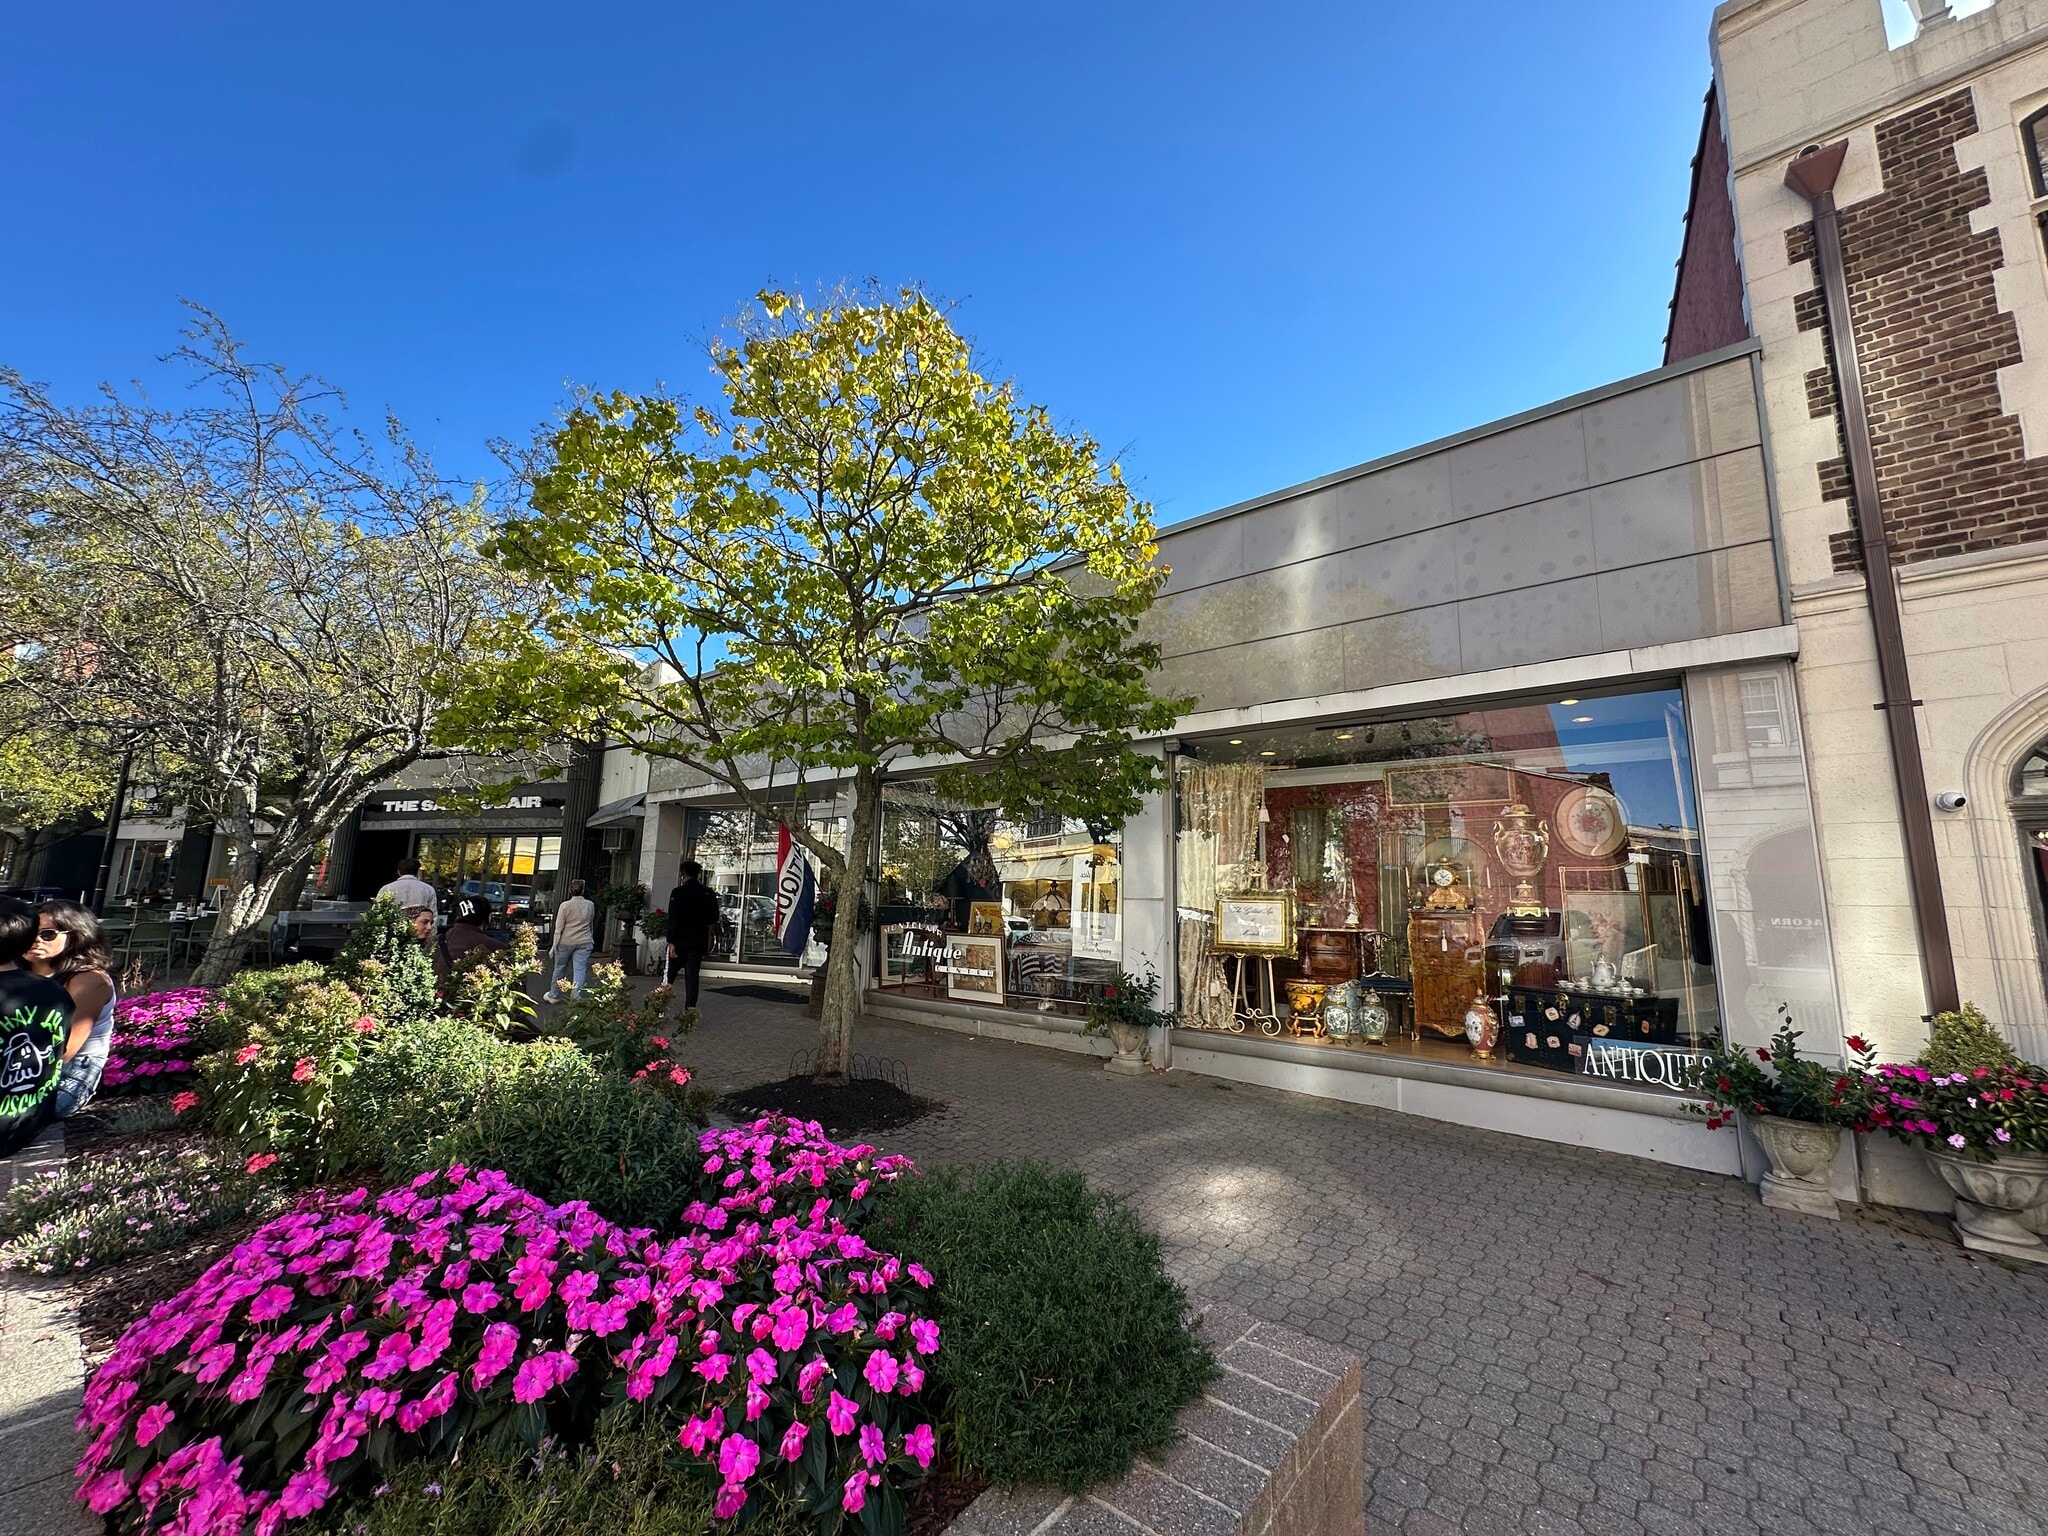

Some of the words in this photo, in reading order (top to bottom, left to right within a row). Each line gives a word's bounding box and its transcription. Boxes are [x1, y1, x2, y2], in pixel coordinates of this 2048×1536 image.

[383, 800, 419, 812] THE
[480, 796, 542, 810] CAIR
[901, 930, 962, 963] Antique
